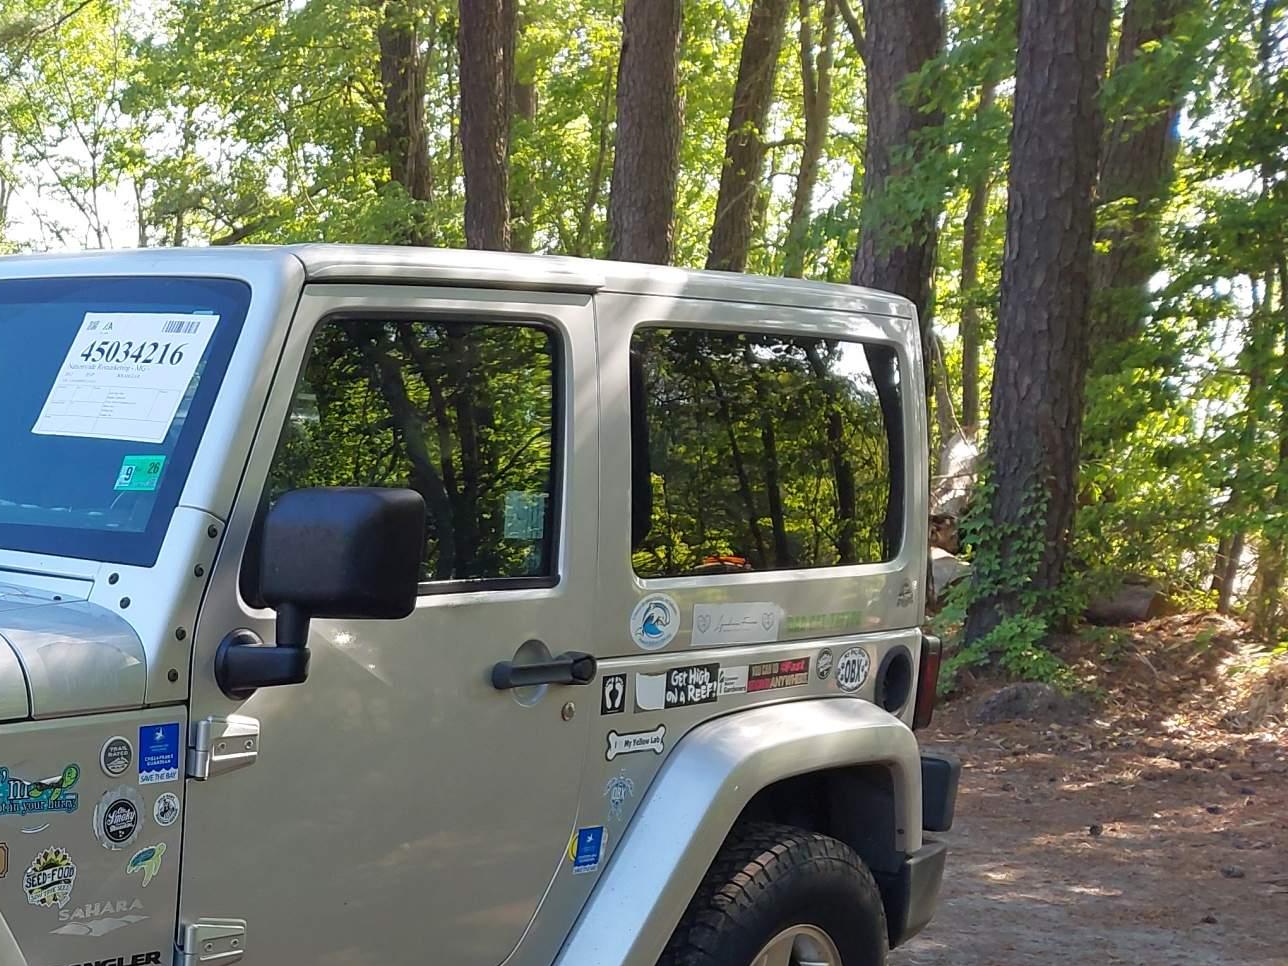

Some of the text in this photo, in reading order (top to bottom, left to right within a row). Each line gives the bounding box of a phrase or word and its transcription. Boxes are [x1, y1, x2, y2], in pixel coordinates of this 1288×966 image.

[80, 340, 190, 365] 45034216
[124, 466, 133, 481] 9
[147, 462, 161, 474] 26
[844, 658, 863, 683] OBX
[687, 681, 717, 702] REEF!
[624, 739, 632, 749] My
[633, 738, 650, 747] Yellow
[650, 736, 660, 744] Lab
[140, 772, 177, 783] SAVE THE BAY
[9, 800, 20, 812] in
[22, 799, 46, 814] your
[58, 898, 144, 921] SAHARA
